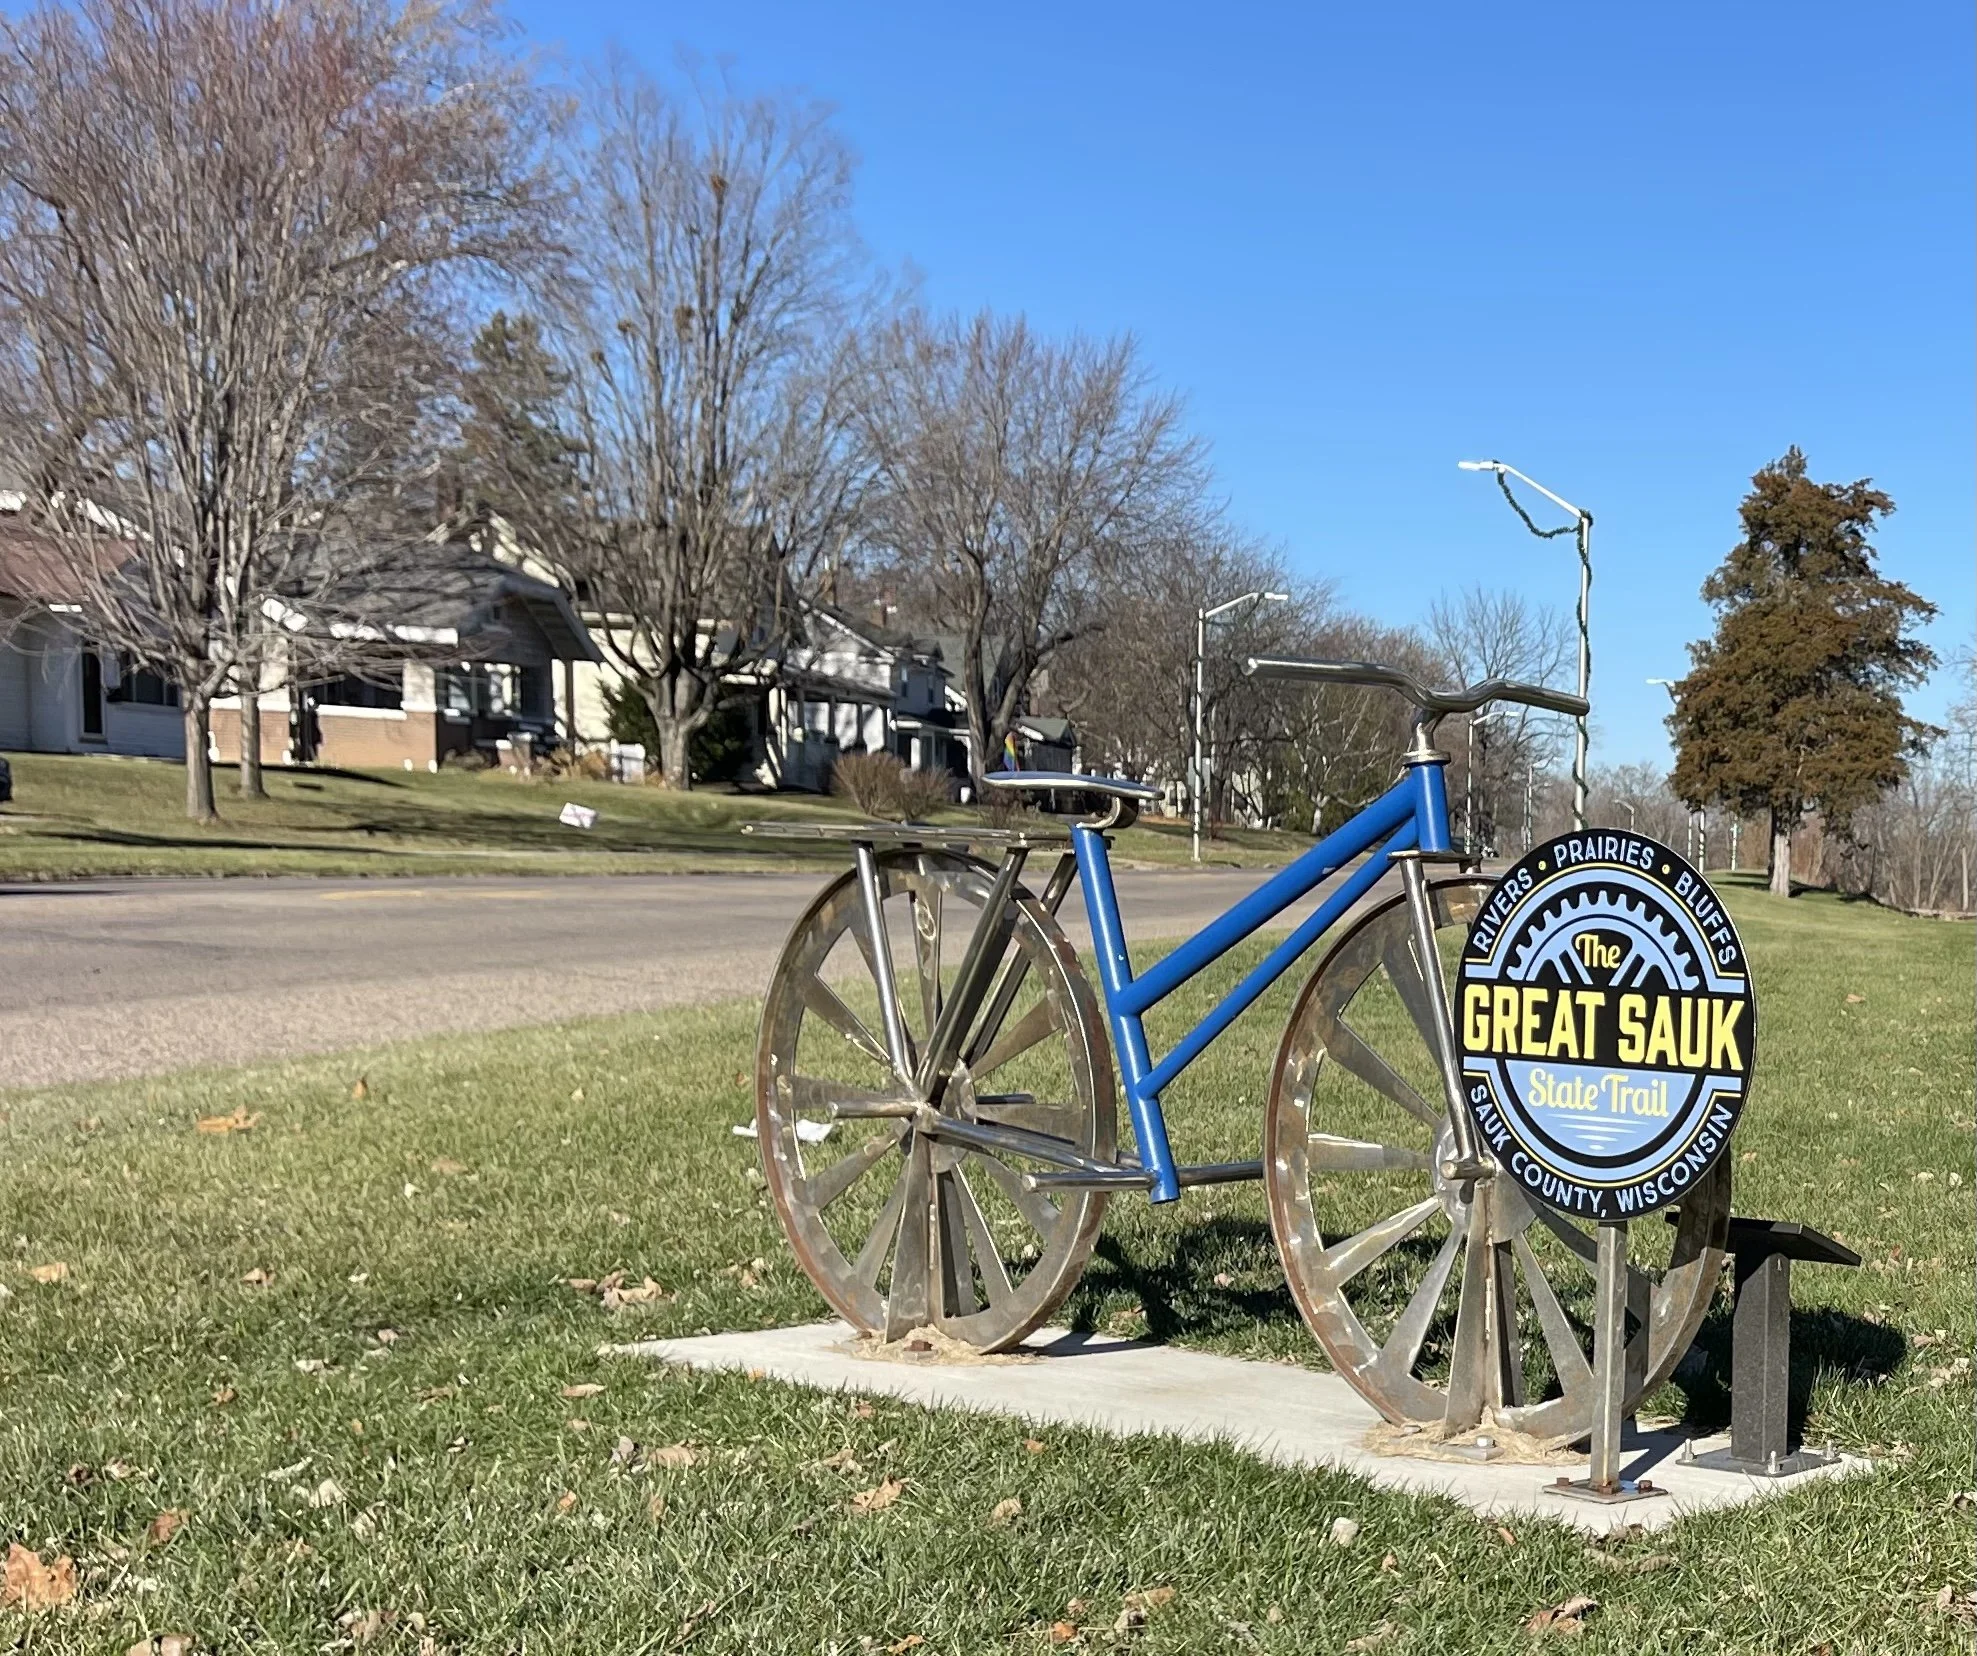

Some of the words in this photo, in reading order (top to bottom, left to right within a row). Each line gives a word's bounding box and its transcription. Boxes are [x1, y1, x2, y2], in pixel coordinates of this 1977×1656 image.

[1472, 867, 1533, 954] RIVERS
[1553, 835, 1655, 871] PRAIRIES
[1675, 871, 1737, 966] BLUFFS
[1574, 933, 1621, 969] The
[1463, 984, 1605, 1060] GREAT
[1617, 993, 1745, 1071] SAUK
[1528, 1068, 1598, 1111] State
[1600, 1077, 1669, 1118] Trail
[1470, 1083, 1512, 1151] SAUK
[1511, 1151, 1607, 1218] COUNTY,
[1615, 1102, 1734, 1214] WISCONSIN
